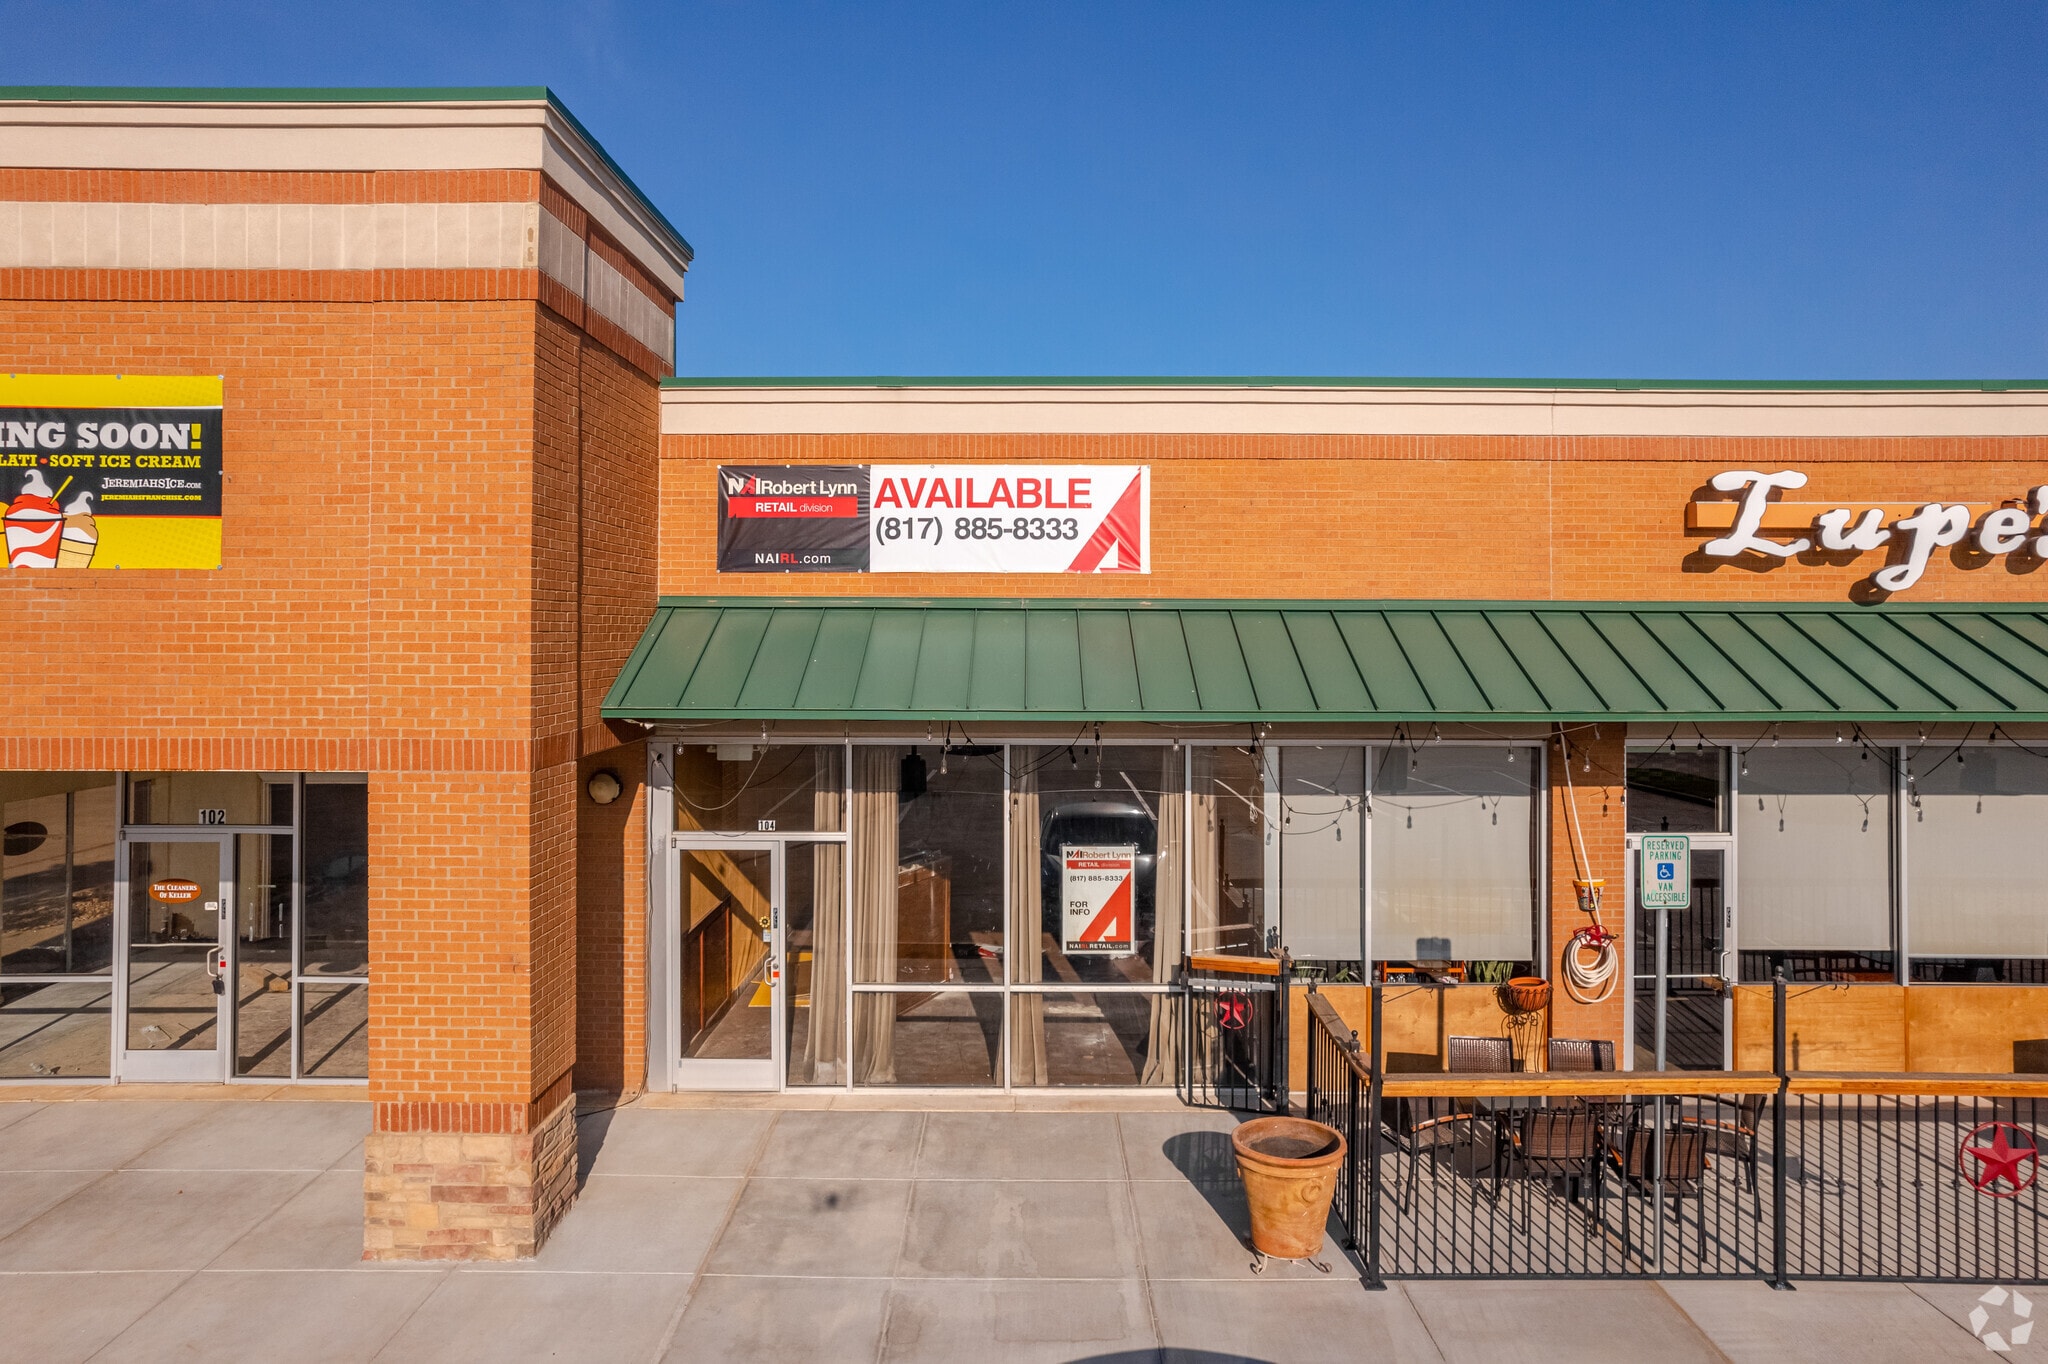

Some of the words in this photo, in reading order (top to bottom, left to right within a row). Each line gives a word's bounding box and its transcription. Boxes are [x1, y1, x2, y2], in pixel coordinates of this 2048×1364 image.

[77, 422, 202, 449] SOON!
[50, 454, 95, 468] SOFT
[100, 455, 131, 468] ICE
[135, 455, 202, 469] CREAM
[819, 479, 858, 497] Lynn
[873, 477, 1092, 509] AVAILABLE
[755, 502, 797, 513] RETAIL
[799, 502, 833, 513] division
[875, 516, 943, 546] (817)
[954, 517, 1079, 541] 885-8333
[755, 552, 831, 564] NAIRL.com
[200, 809, 225, 824] 102
[760, 821, 775, 831] 104
[1646, 840, 1685, 850] RESERVED
[1112, 850, 1131, 860] Lynn
[1649, 851, 1682, 861] PARKING
[1658, 882, 1673, 891] VAN
[168, 891, 192, 899] KELLER
[1646, 892, 1686, 902] ACCESSIBLE
[1069, 900, 1088, 908] FOR
[1069, 908, 1091, 916] INFO
